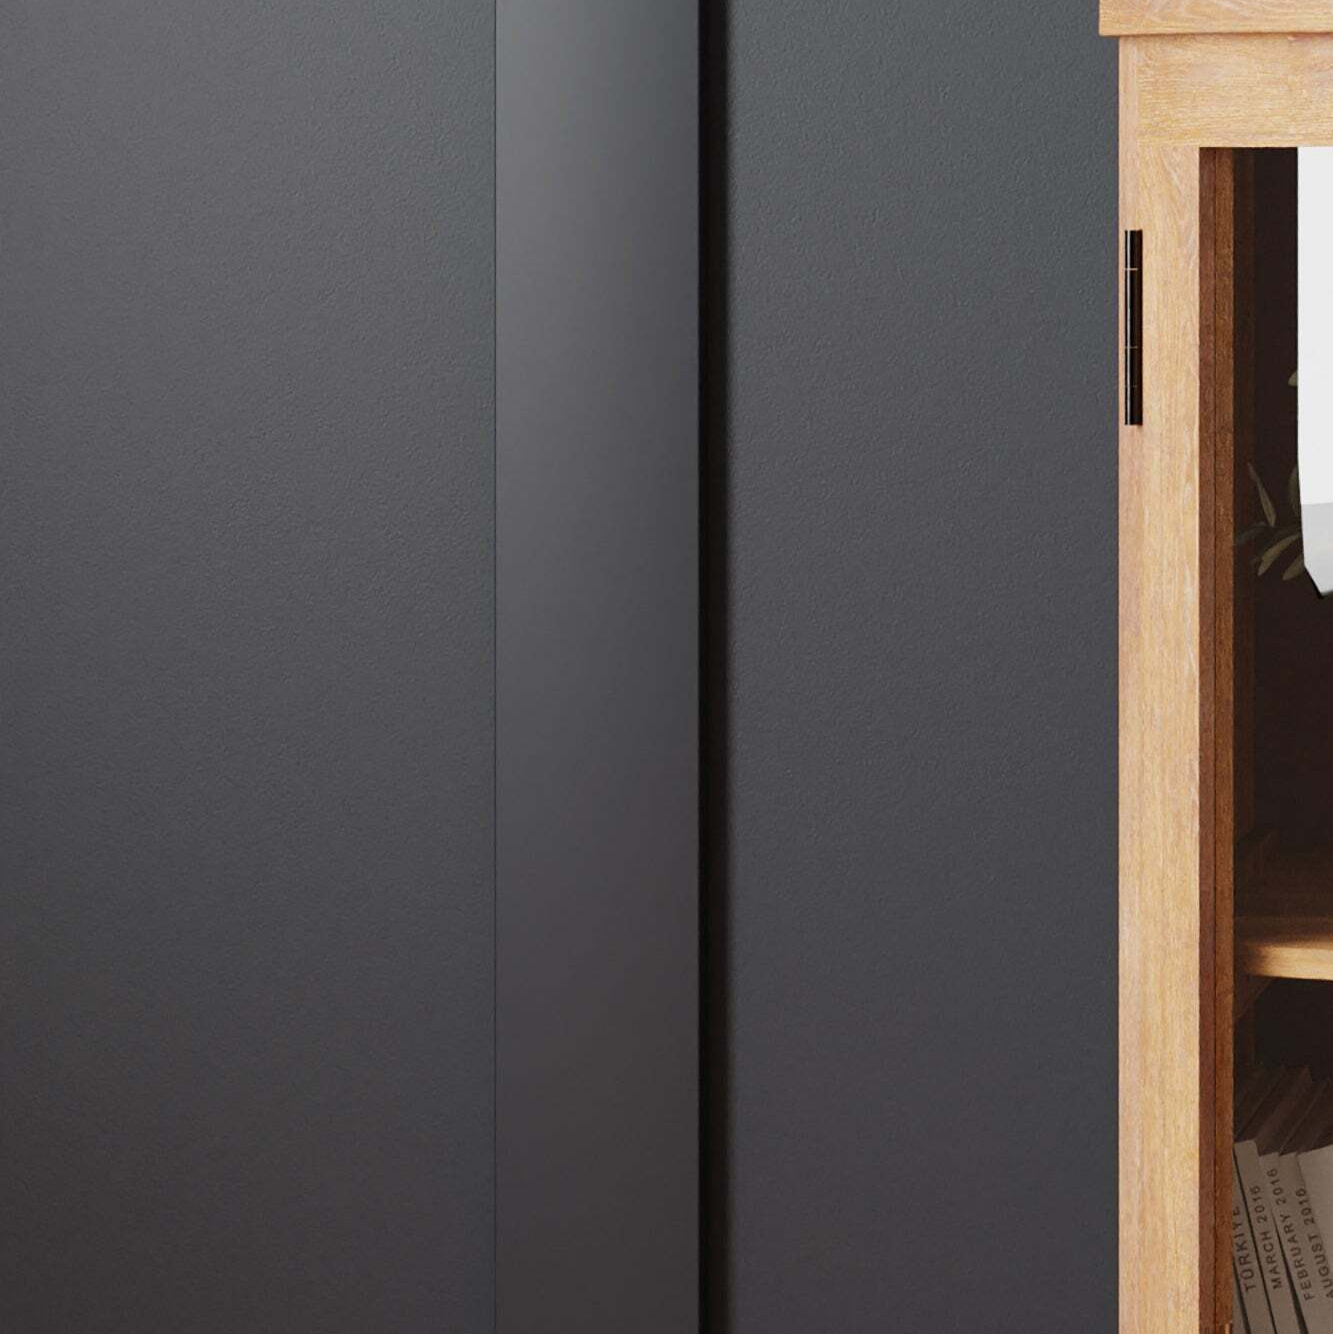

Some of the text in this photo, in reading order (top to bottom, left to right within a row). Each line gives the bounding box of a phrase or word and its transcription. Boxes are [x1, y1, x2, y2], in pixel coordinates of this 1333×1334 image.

[1266, 1167, 1315, 1301] FEBRUARY 2016
[1295, 1187, 1316, 1226] 2016
[1261, 1231, 1283, 1290] MARCH
